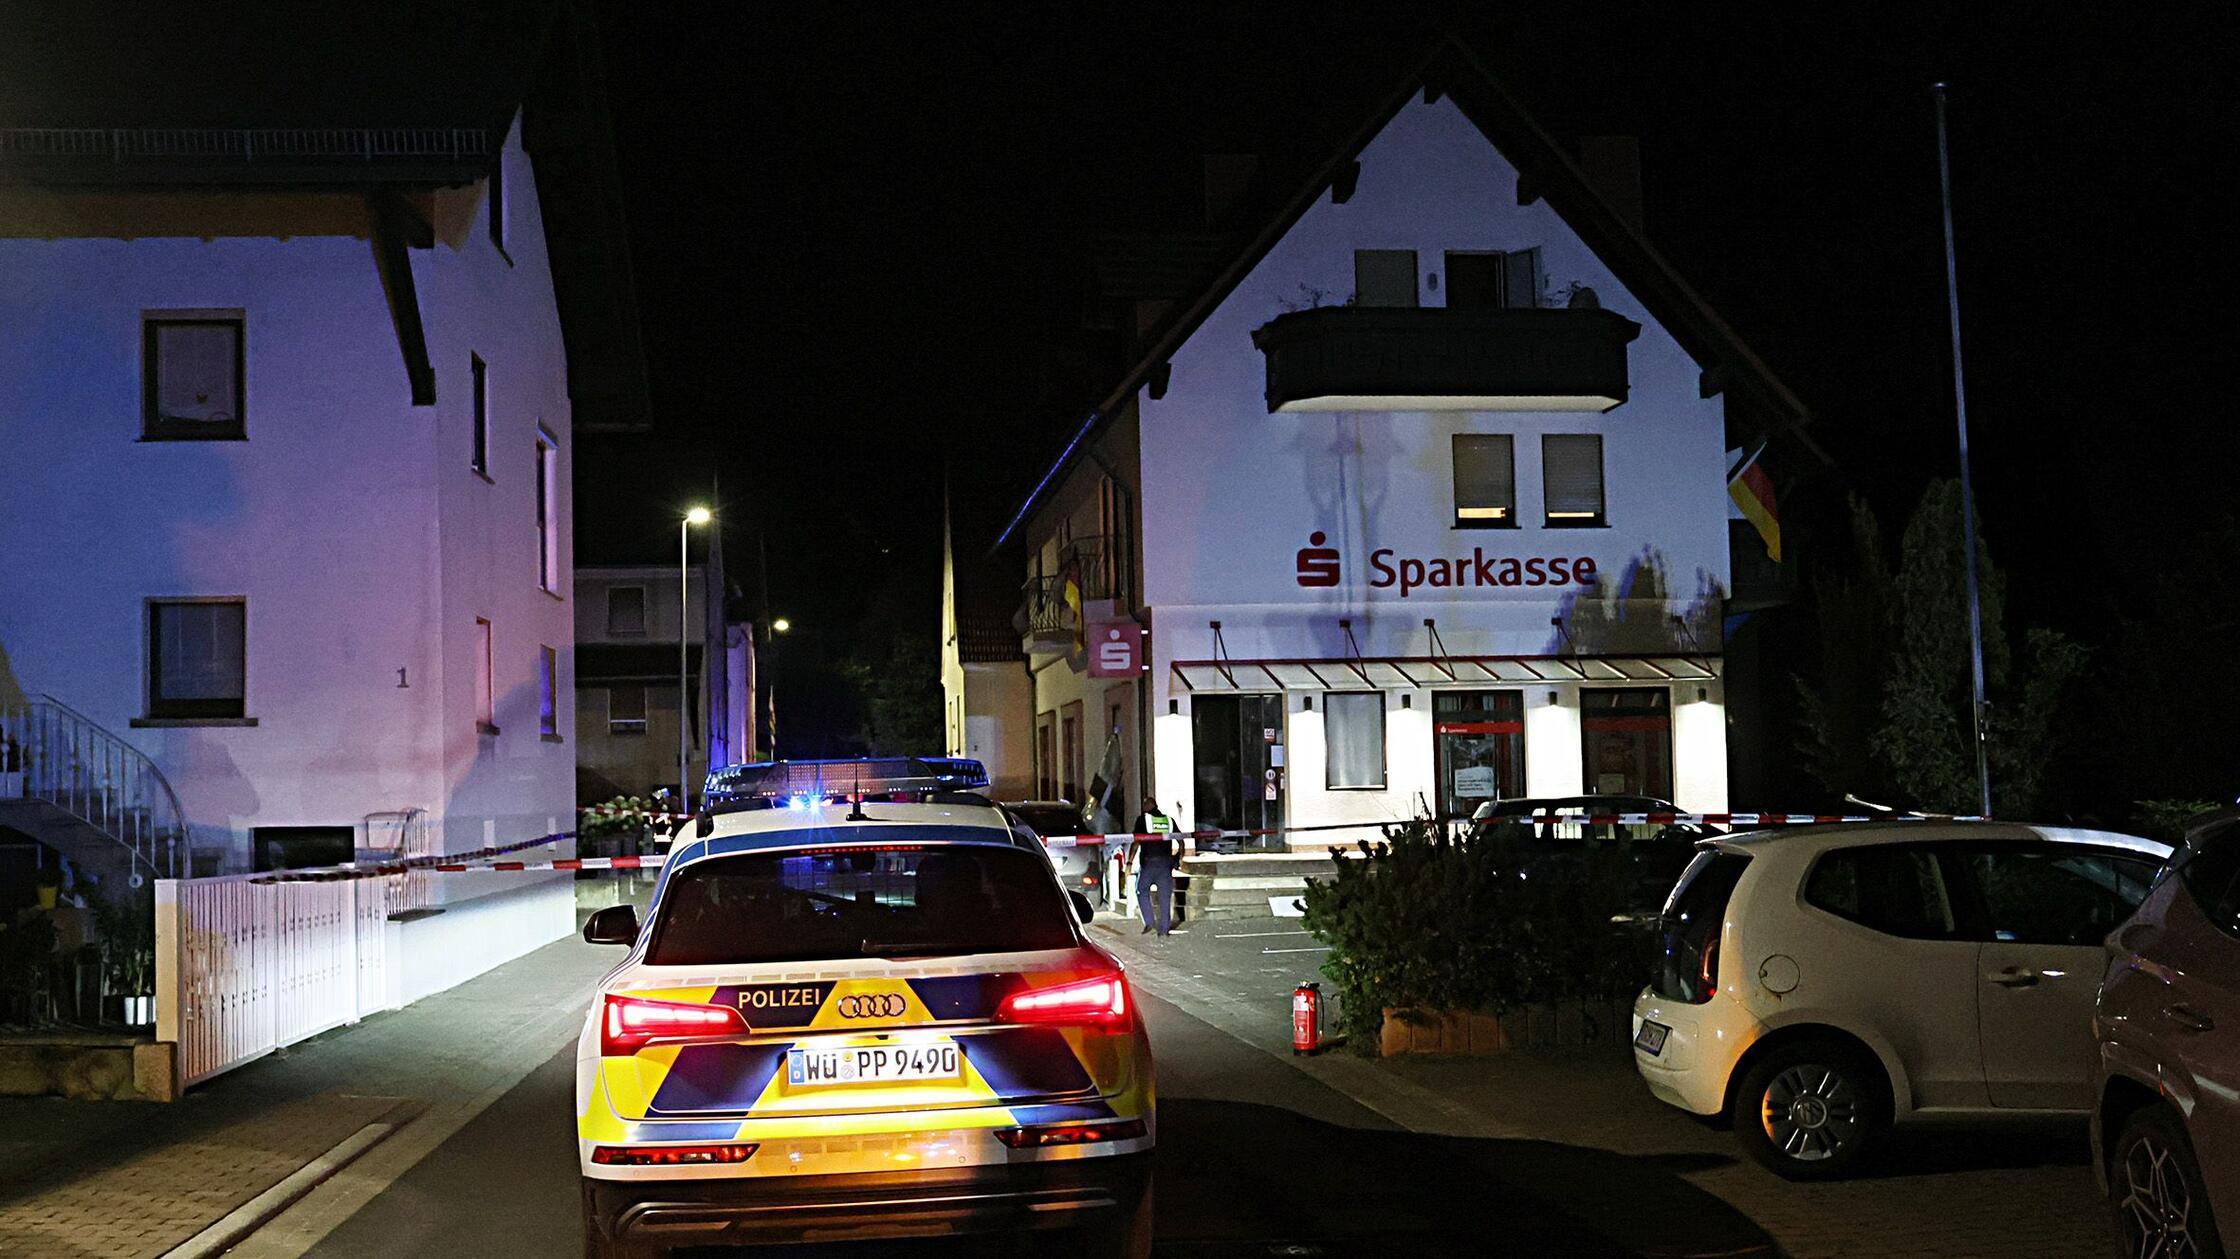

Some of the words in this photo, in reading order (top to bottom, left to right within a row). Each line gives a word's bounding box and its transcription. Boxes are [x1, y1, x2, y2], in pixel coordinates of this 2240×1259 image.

[1370, 547, 1597, 597] Sparkasse
[397, 667, 410, 688] 1
[738, 988, 820, 1009] POLIZEI
[857, 1050, 887, 1077] PP
[895, 1048, 955, 1075] 9490
